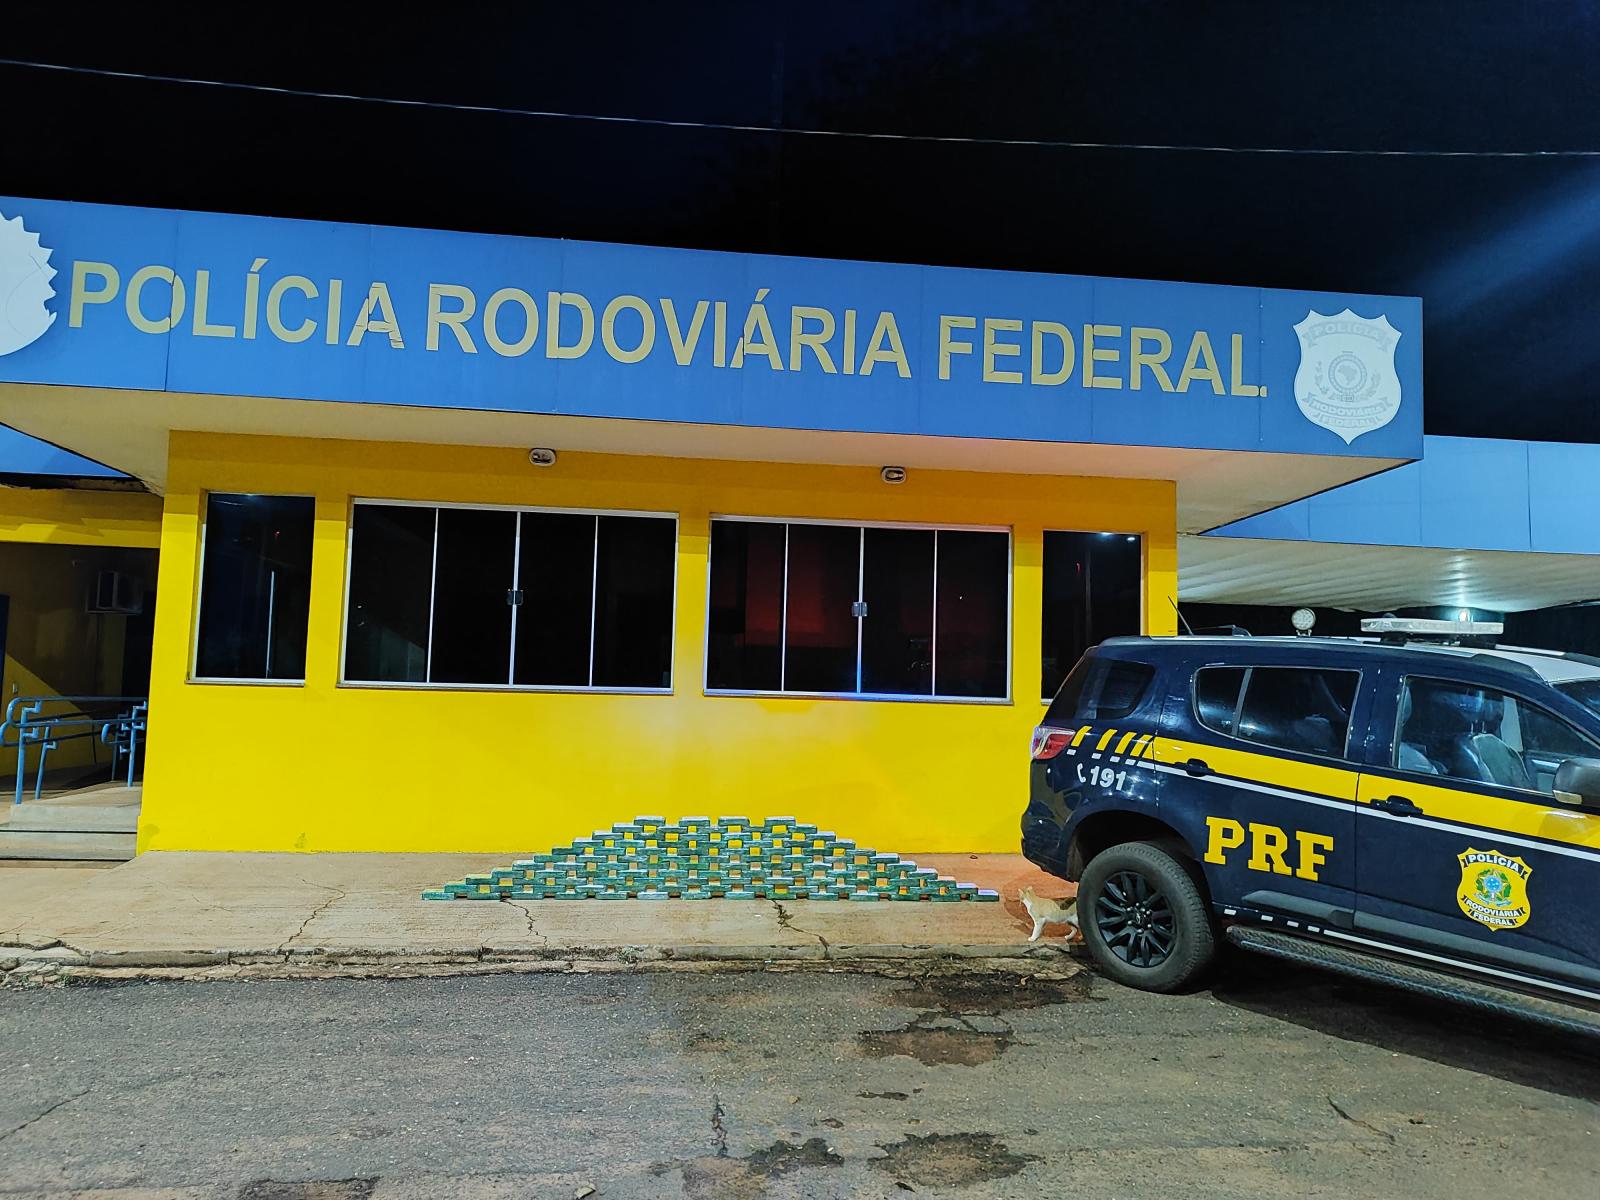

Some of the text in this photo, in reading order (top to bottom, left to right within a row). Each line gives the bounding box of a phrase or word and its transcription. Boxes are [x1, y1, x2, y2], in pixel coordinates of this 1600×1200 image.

[68, 258, 1267, 398] POLÍCIA RODOVIÁRIA FEDERAL
[1322, 416, 1375, 427] FEDERAL
[1090, 765, 1127, 791] 191
[1204, 815, 1334, 882] PRF
[1473, 911, 1513, 926] FEDERAL
